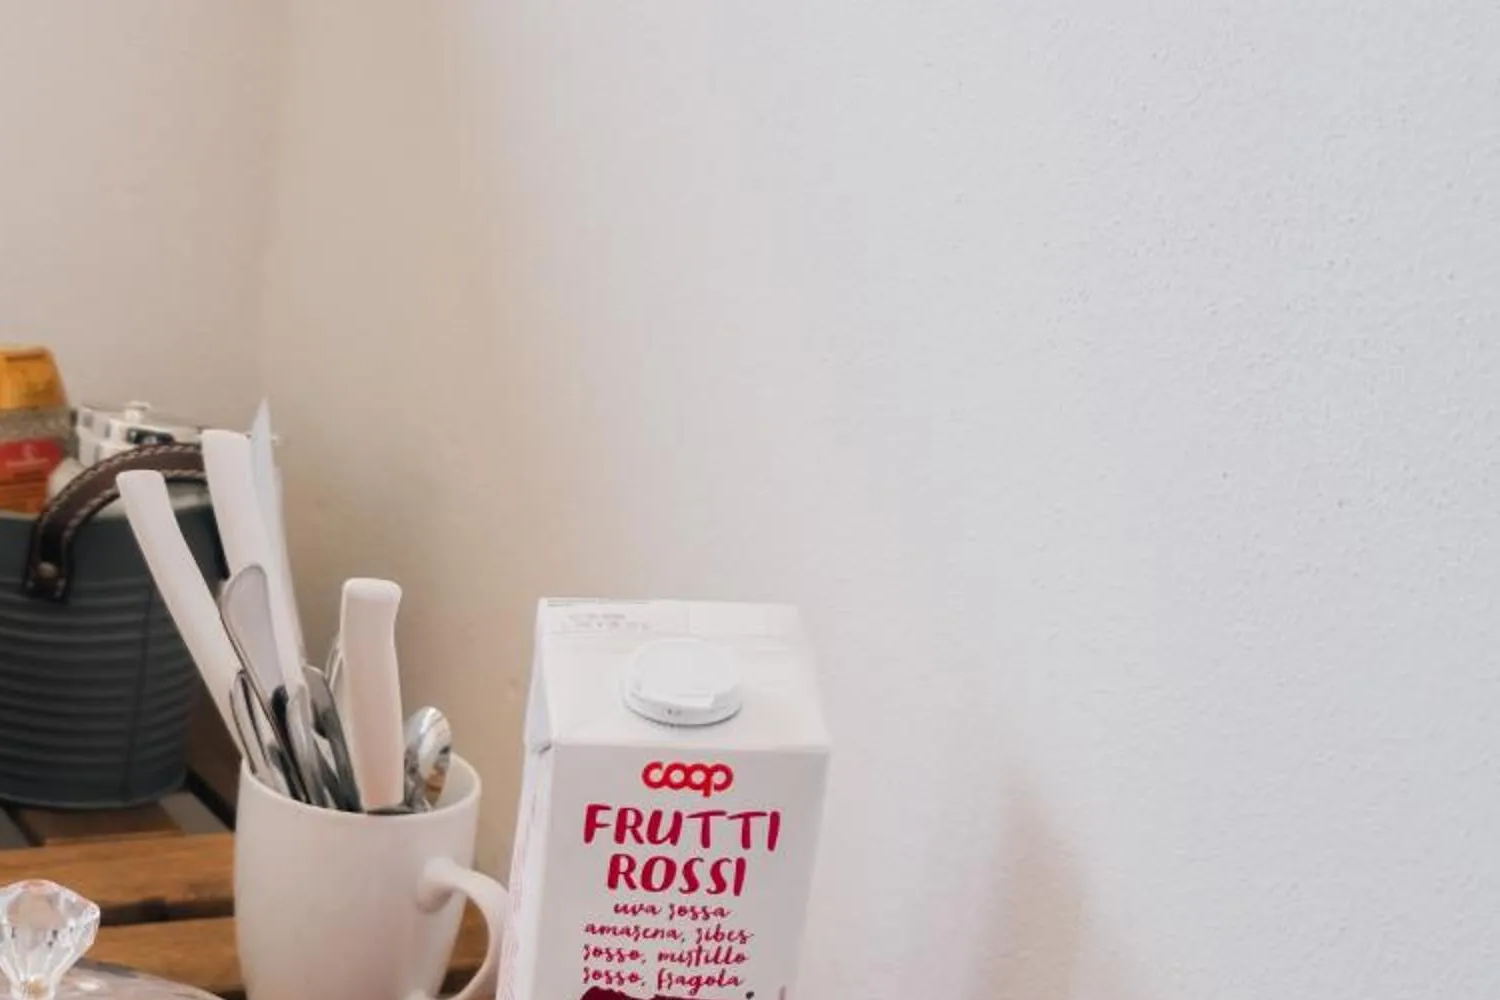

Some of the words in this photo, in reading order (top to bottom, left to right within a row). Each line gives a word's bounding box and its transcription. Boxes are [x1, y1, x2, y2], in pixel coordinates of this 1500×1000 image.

[641, 761, 734, 797] coop
[583, 804, 781, 851] FRUTTI
[606, 853, 747, 896] ROSSI
[613, 903, 661, 916] uva
[668, 903, 733, 920] rossa
[656, 968, 744, 996] fragola
